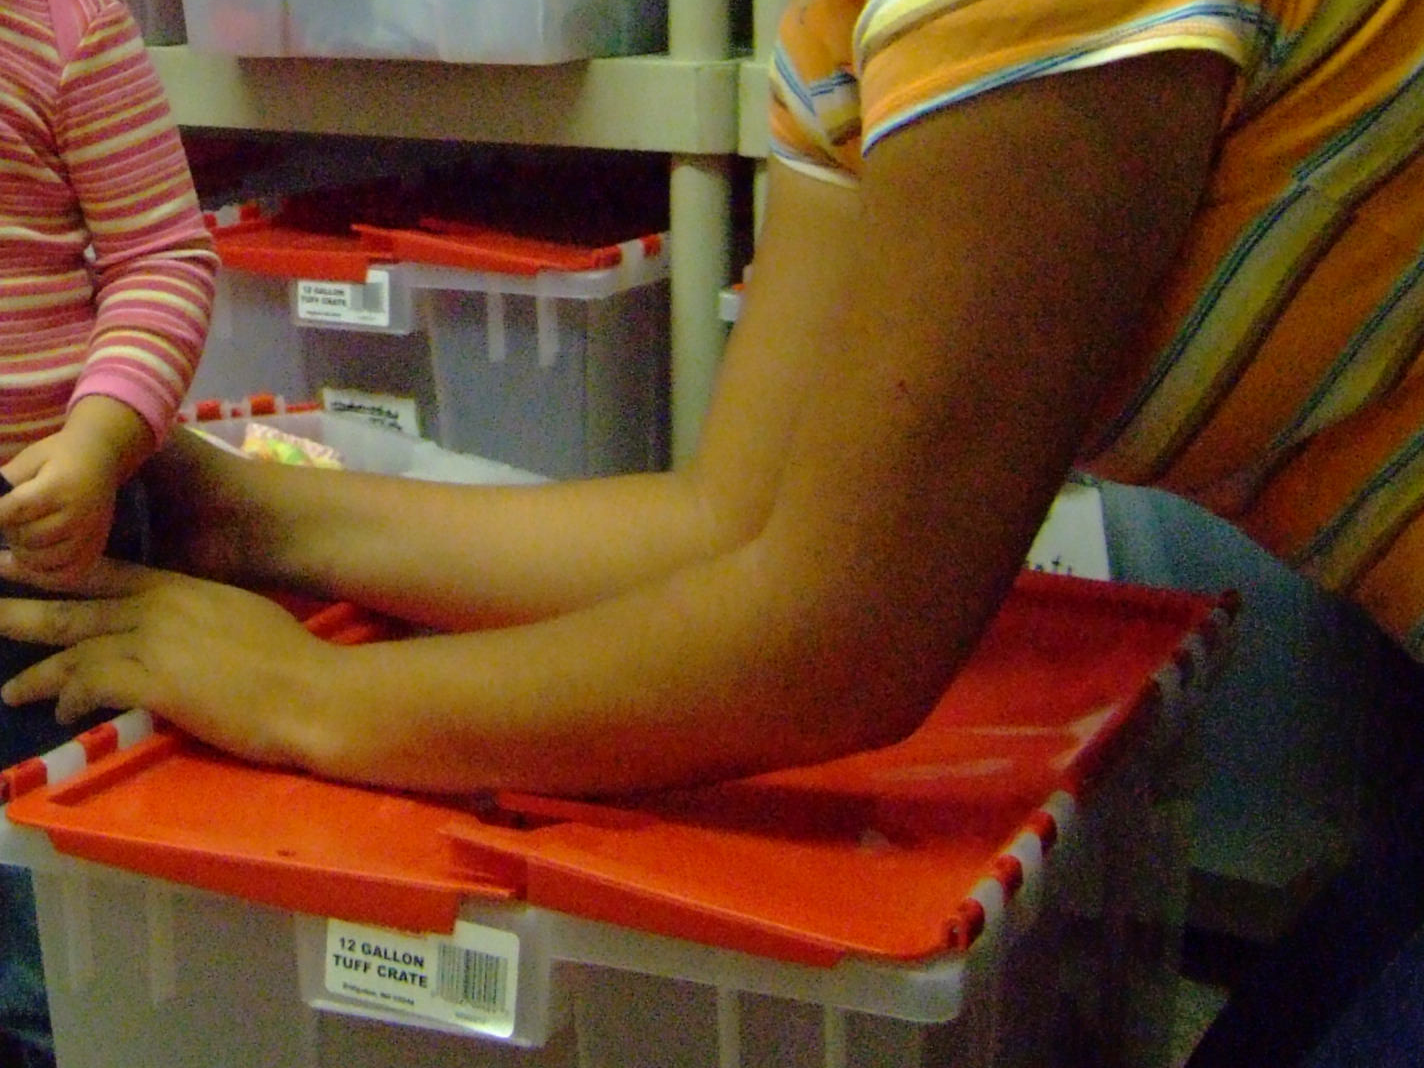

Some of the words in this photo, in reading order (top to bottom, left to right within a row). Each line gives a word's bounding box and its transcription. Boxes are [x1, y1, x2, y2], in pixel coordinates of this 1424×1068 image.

[339, 937, 356, 952] 12
[361, 942, 425, 968] GALLON
[333, 954, 372, 973] TUFF
[377, 964, 427, 988] CRATE
